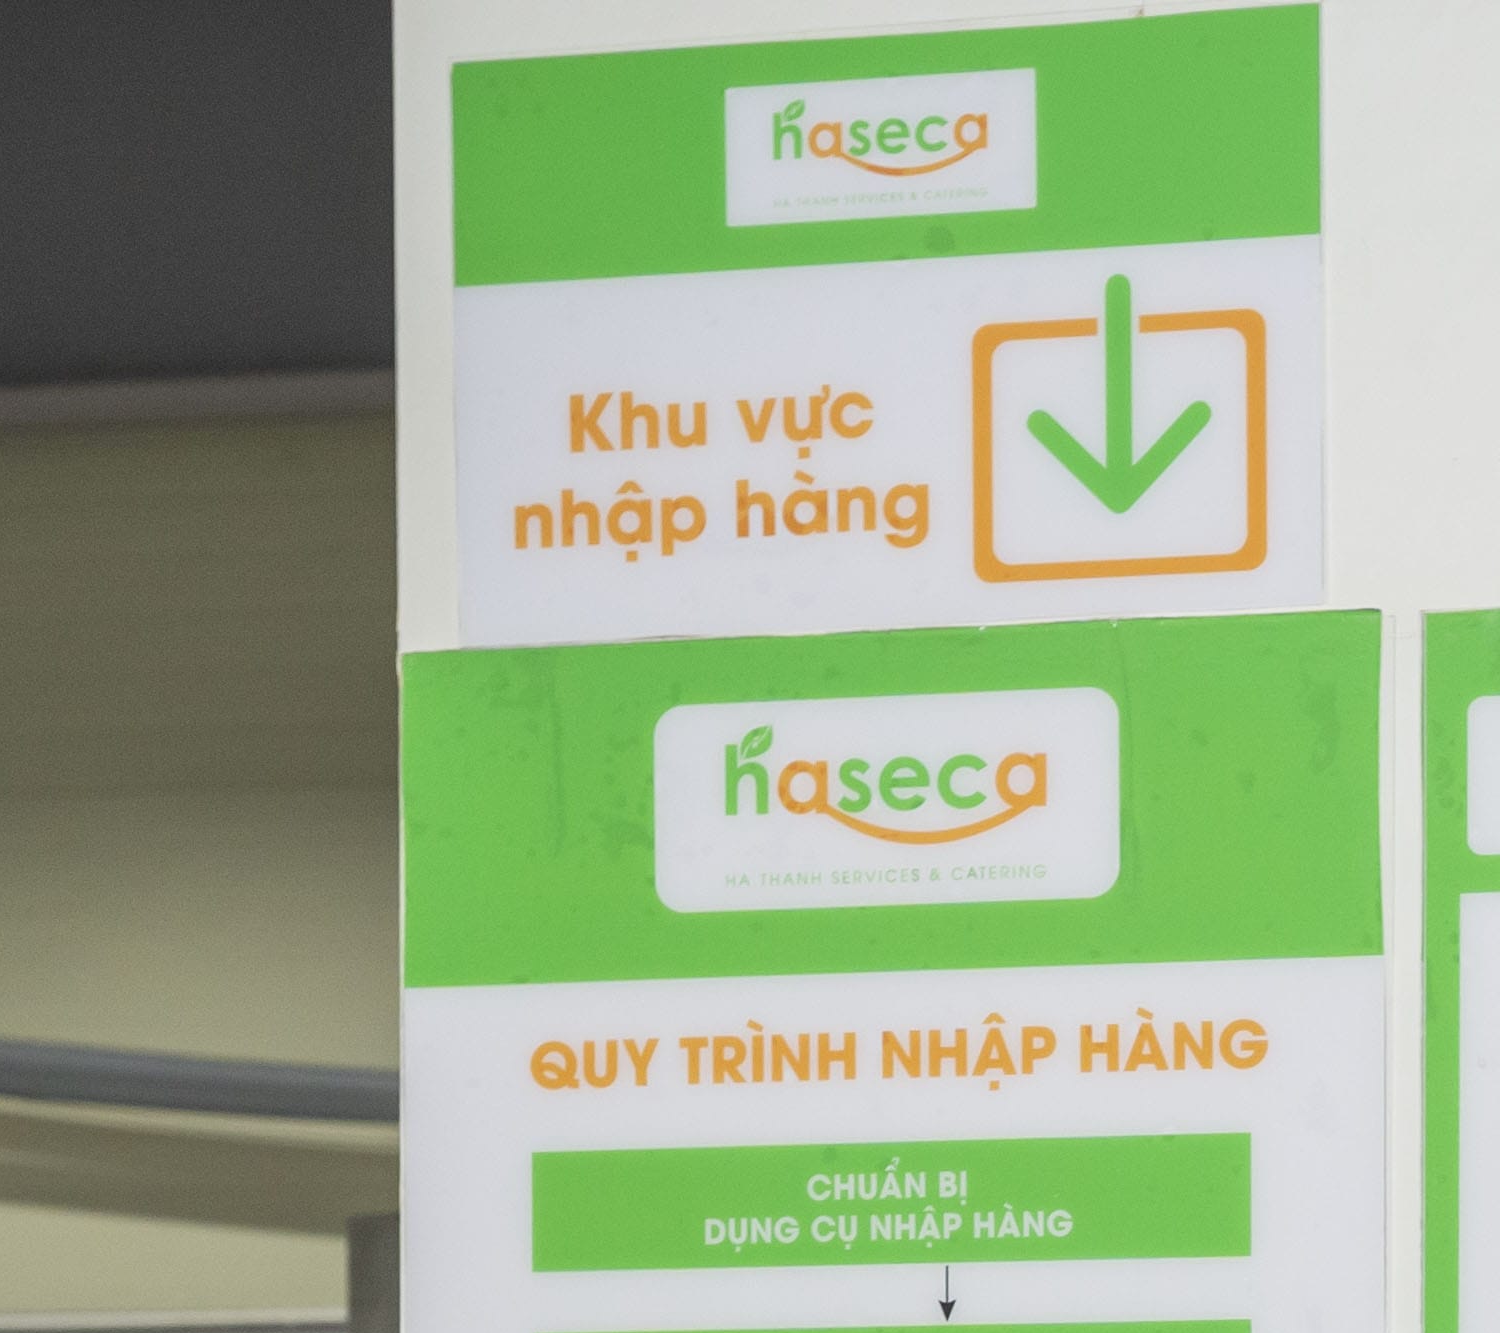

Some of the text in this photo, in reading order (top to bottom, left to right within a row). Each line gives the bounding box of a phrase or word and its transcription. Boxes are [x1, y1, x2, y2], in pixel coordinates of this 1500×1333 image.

[772, 100, 988, 168] haseca
[568, 384, 874, 459] Khu vực
[514, 470, 931, 563] nhập hàng
[725, 725, 1047, 833] haseca
[761, 872, 822, 887] THANH
[831, 868, 920, 885] SERVICES
[930, 868, 941, 881] &
[952, 864, 1048, 881] CATERING
[530, 1008, 1269, 1090] QUY TRÌNH NHẬP HÀNG
[807, 1156, 967, 1206] CHUẨN BỊ
[705, 1202, 1073, 1252] DỤNG CỤ NHẬP HÀNG
